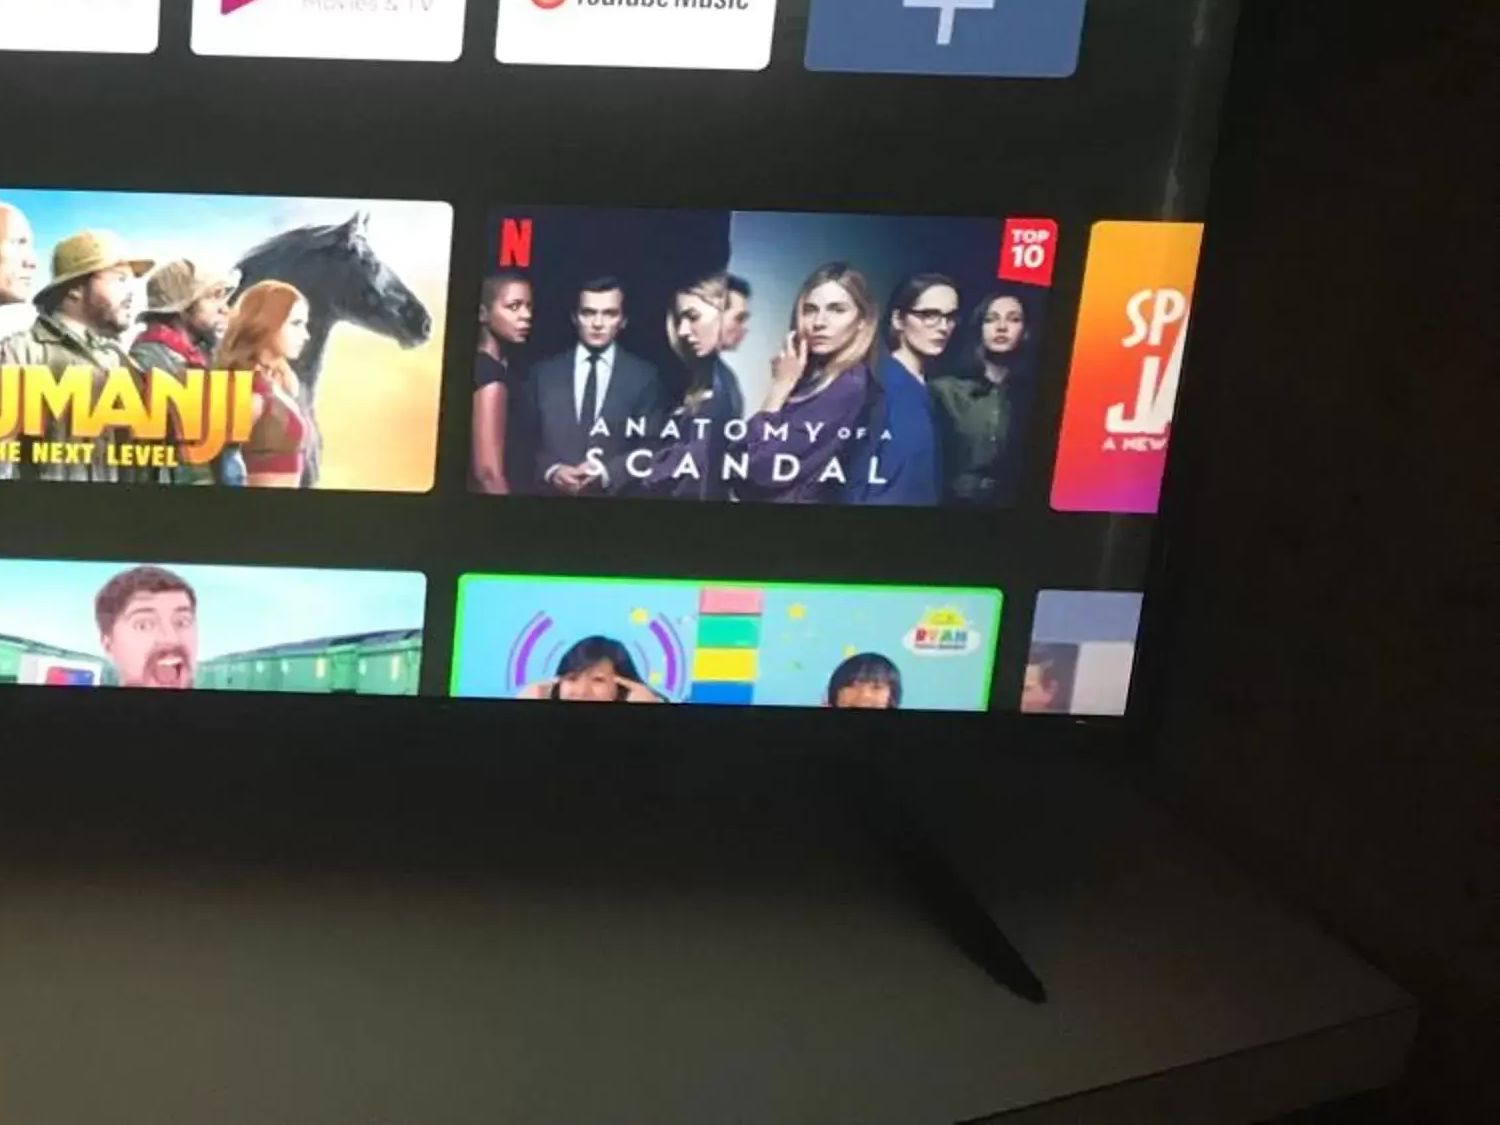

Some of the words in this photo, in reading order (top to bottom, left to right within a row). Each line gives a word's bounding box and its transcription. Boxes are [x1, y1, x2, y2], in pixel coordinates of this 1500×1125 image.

[1012, 228, 1050, 245] TOP
[1010, 244, 1044, 269] 10
[589, 415, 826, 443] ANATOMY
[838, 427, 867, 441] OF
[881, 428, 893, 442] A
[32, 442, 92, 465] NEXT
[107, 444, 178, 468] LEVEL
[585, 448, 888, 485] SCANDAL
